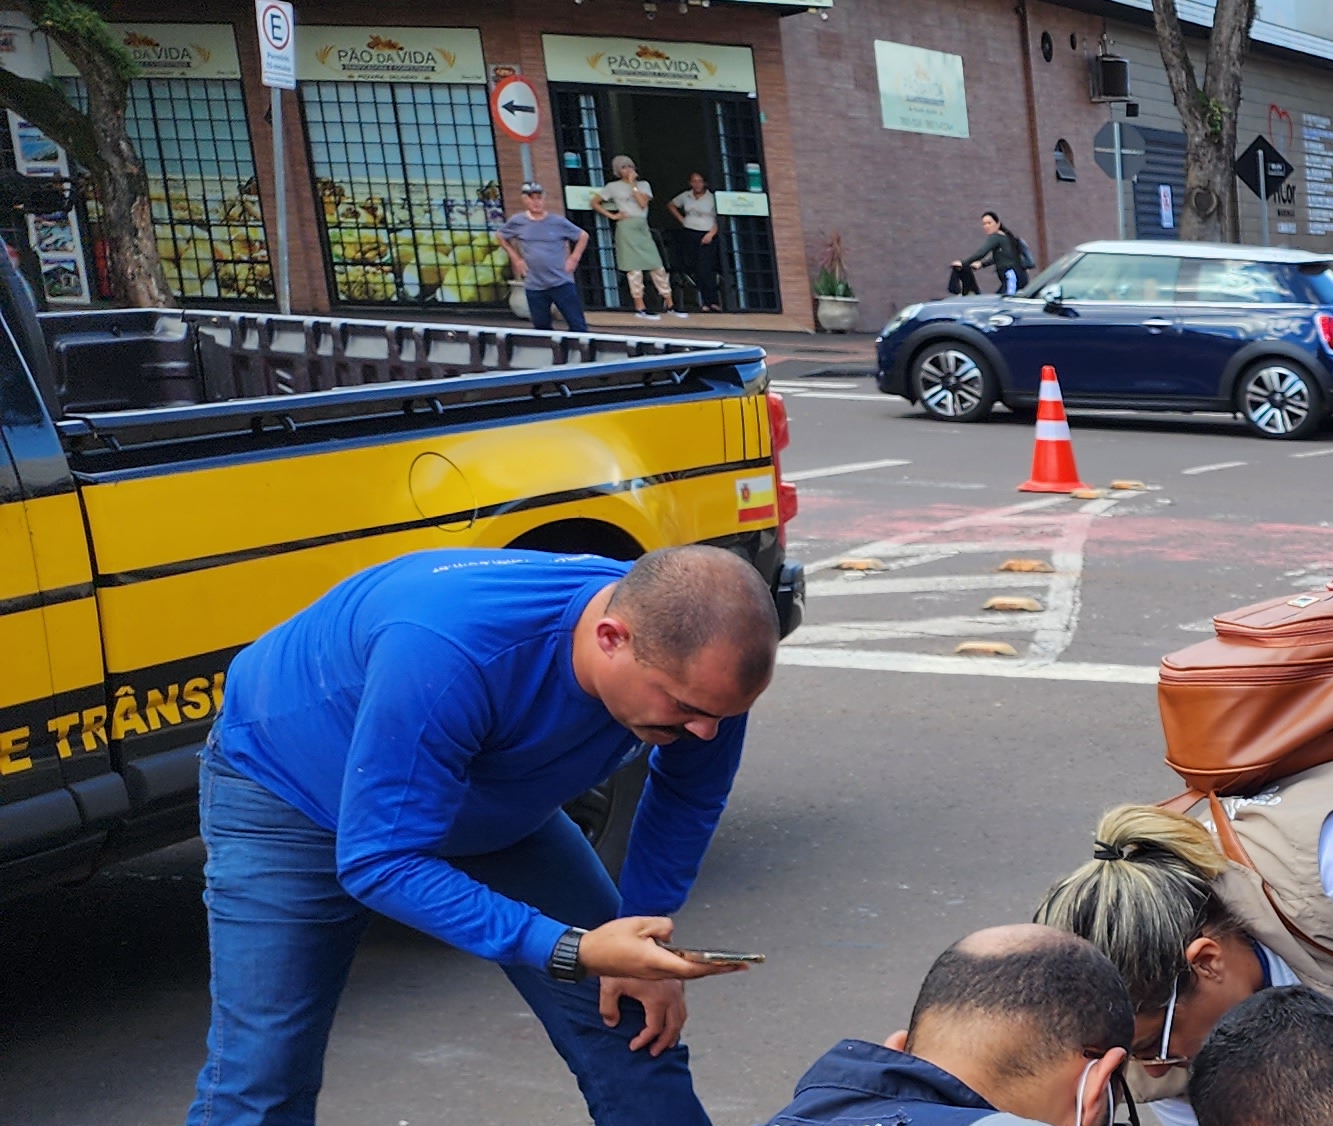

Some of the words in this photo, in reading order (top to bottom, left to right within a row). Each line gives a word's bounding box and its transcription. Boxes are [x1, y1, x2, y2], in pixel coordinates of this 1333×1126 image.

[270, 13, 283, 41] E
[152, 48, 193, 61] VIDA
[337, 47, 373, 64] PÃO
[376, 53, 395, 64] DA
[396, 50, 438, 64] VIDA
[607, 55, 641, 70] PÃO
[644, 62, 662, 71] DA
[664, 58, 700, 73] VIDA
